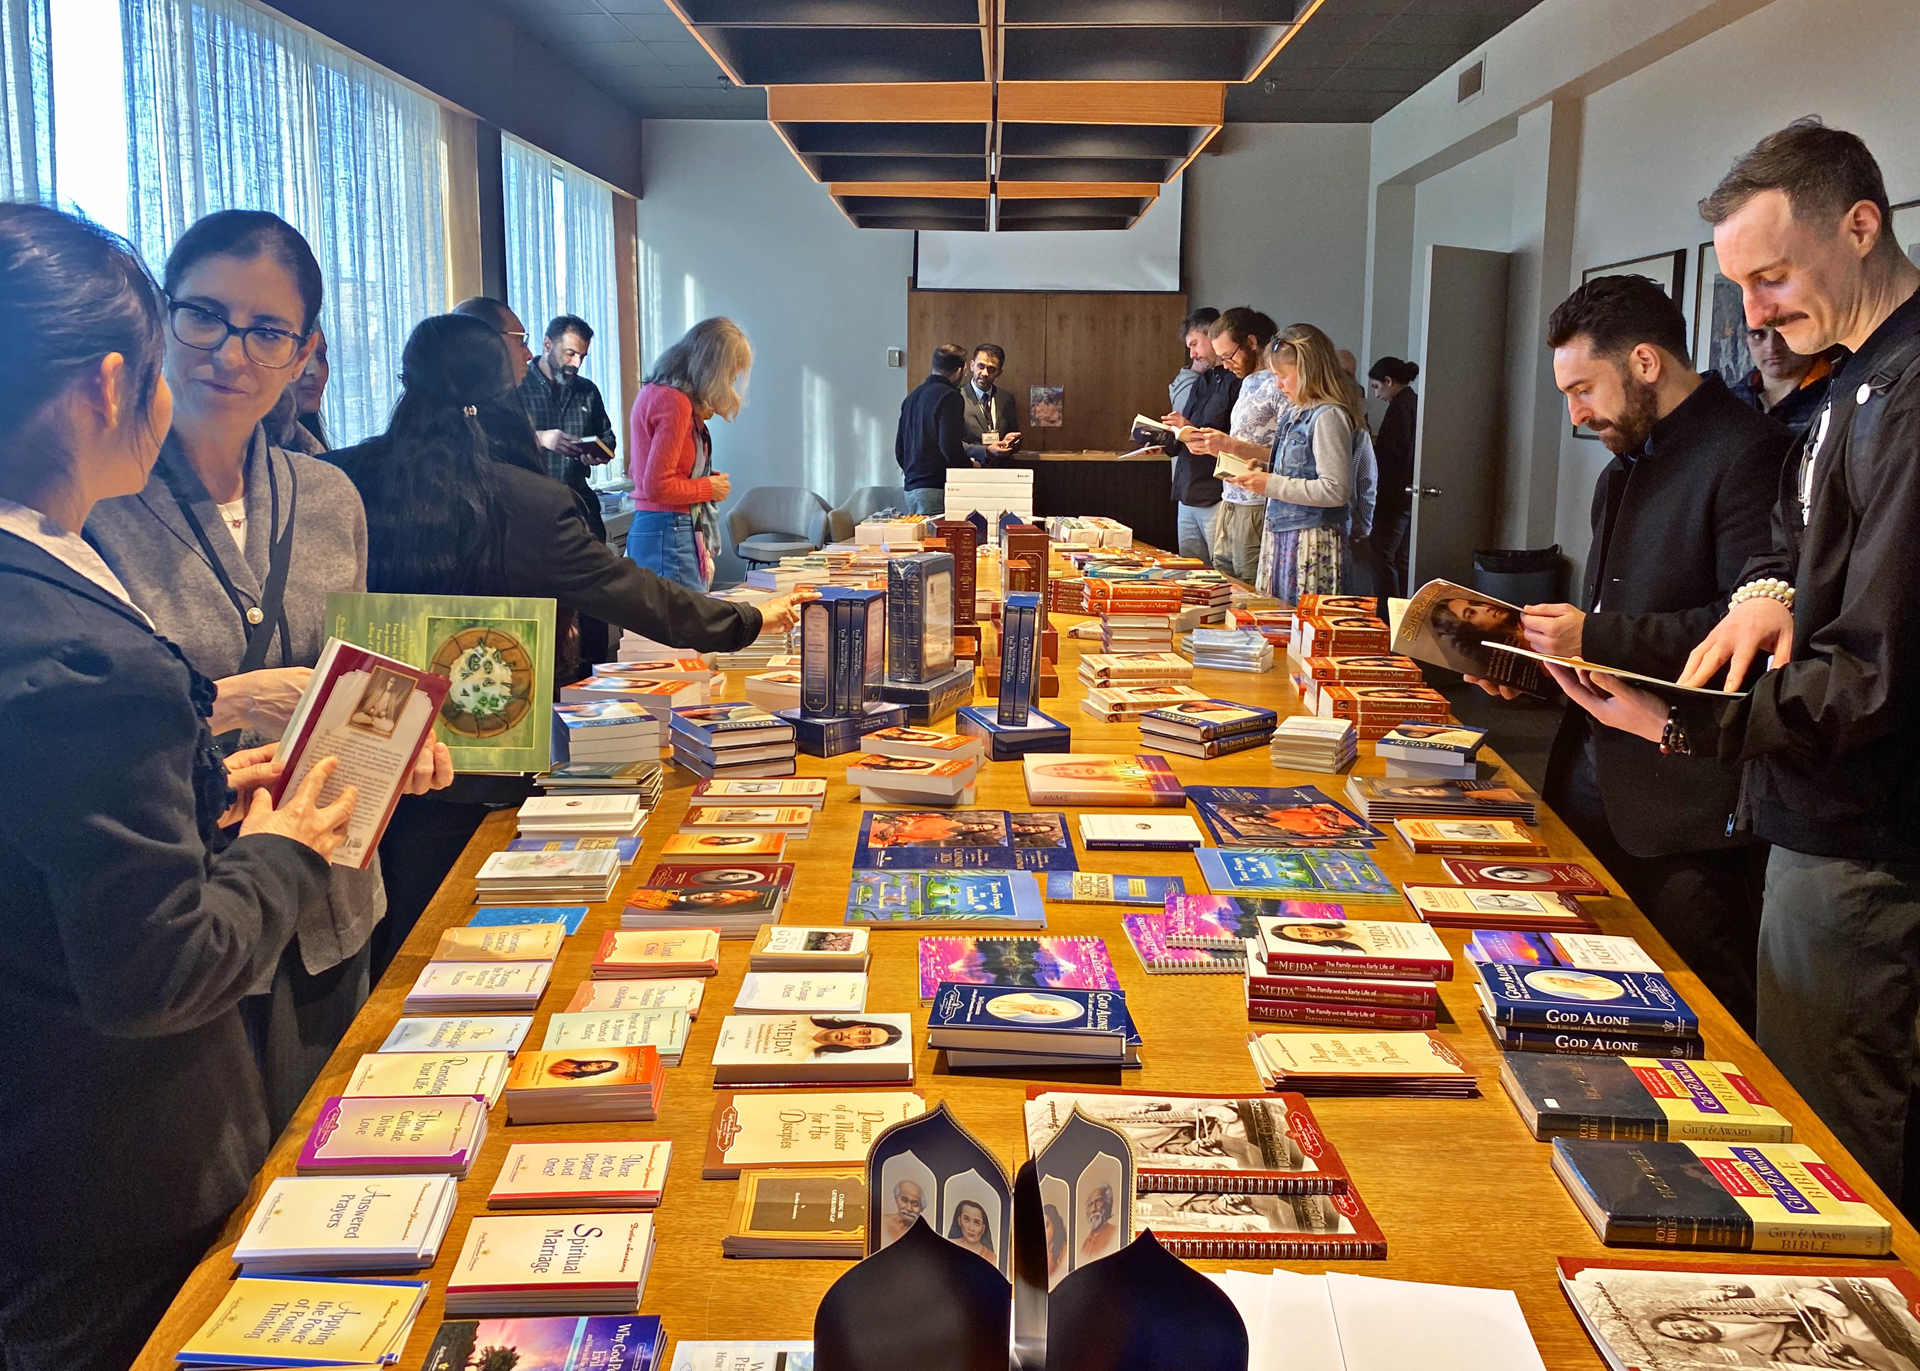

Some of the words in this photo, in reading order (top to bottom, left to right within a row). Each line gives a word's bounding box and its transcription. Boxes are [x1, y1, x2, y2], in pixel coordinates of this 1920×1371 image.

[1116, 588, 1149, 596] Autobiography
[1346, 670, 1381, 678] Autobiography
[1368, 702, 1406, 710] Autobiography
[1226, 722, 1240, 732] DIVINE
[1241, 719, 1263, 729] ROMANCE
[1370, 714, 1407, 722] Autobiography
[1229, 738, 1243, 747] DIVINE
[1243, 734, 1265, 744] ROMANCE
[954, 848, 964, 868] CALENDAR
[1233, 857, 1248, 871] Frogs
[1078, 875, 1093, 896] SCIENCE
[1236, 872, 1251, 882] Two
[966, 886, 977, 905] Trouble
[990, 882, 1001, 893] Two
[989, 893, 1003, 910] Frogs
[494, 932, 510, 951] Character
[773, 930, 790, 950] GOD
[1584, 938, 1617, 965] LIGHT
[1275, 960, 1318, 972] "MEJDA"
[1336, 962, 1351, 970] Family
[1367, 963, 1379, 971] Early
[1494, 963, 1512, 982] ALONE
[451, 970, 467, 986] Success
[1256, 984, 1299, 996] "MEJDA"
[1317, 986, 1332, 994] Family
[1348, 988, 1360, 996] Early
[1502, 983, 1521, 998] GOD
[1096, 993, 1112, 1008] GOD
[1096, 1009, 1112, 1030] ALONE
[1254, 1006, 1298, 1018] "MEJDA"
[1316, 1008, 1332, 1017] Family
[1545, 1009, 1579, 1023] GOD
[1582, 1011, 1630, 1026] ALONE
[774, 1020, 797, 1057] "MEJDA"
[1555, 1035, 1588, 1048] GOD
[1591, 1038, 1638, 1051] ALONE
[419, 1061, 436, 1077] Your
[426, 1056, 468, 1095] Remolding
[1671, 1061, 1696, 1084] AWARD
[413, 1076, 430, 1090] Life
[1700, 1070, 1739, 1102] BIBLE
[831, 1104, 853, 1113] of
[1694, 1090, 1719, 1110] GIFT
[414, 1109, 443, 1134] How
[807, 1112, 829, 1125] for
[1047, 1101, 1060, 1129] Yogananda
[356, 1118, 374, 1135] Love
[374, 1115, 394, 1137] Divine
[391, 1110, 414, 1141] Cultivate
[776, 1108, 807, 1150] Disciples
[809, 1126, 830, 1140] His
[856, 1110, 884, 1145] Prayers
[1682, 1124, 1706, 1134] GIFT
[1715, 1126, 1752, 1136] AWARD
[410, 1134, 420, 1142] to
[835, 1121, 854, 1151] Master
[603, 1154, 617, 1165] Are
[1267, 1137, 1292, 1168] COSMIC
[542, 1158, 560, 1177] Ones?
[561, 1158, 579, 1176] Loved
[579, 1153, 599, 1180] Departed
[599, 1166, 614, 1178] Our
[618, 1154, 644, 1178] Where
[1742, 1150, 1777, 1178] AWARD
[1645, 1174, 1677, 1199] HOLY
[1778, 1161, 1829, 1200] BIBLE
[1778, 1187, 1808, 1210] GIFT
[327, 1194, 356, 1228] Prayers
[343, 1184, 391, 1239] Answered
[1769, 1228, 1795, 1239] GIFT
[1798, 1228, 1808, 1239] &
[1805, 1229, 1846, 1241] AWARD
[531, 1229, 564, 1274] Marriage
[562, 1223, 603, 1274] Spiritual
[1781, 1240, 1830, 1250] BIBLE
[297, 1299, 309, 1311] of
[312, 1301, 334, 1316] the
[1594, 1281, 1628, 1321] Yogananda
[244, 1302, 289, 1339] Thinking
[267, 1311, 305, 1343] Positive
[290, 1315, 322, 1344] Power
[308, 1301, 361, 1345] Applying
[611, 1323, 632, 1343] Why
[590, 1350, 607, 1367] Evil
[610, 1344, 626, 1362] God
